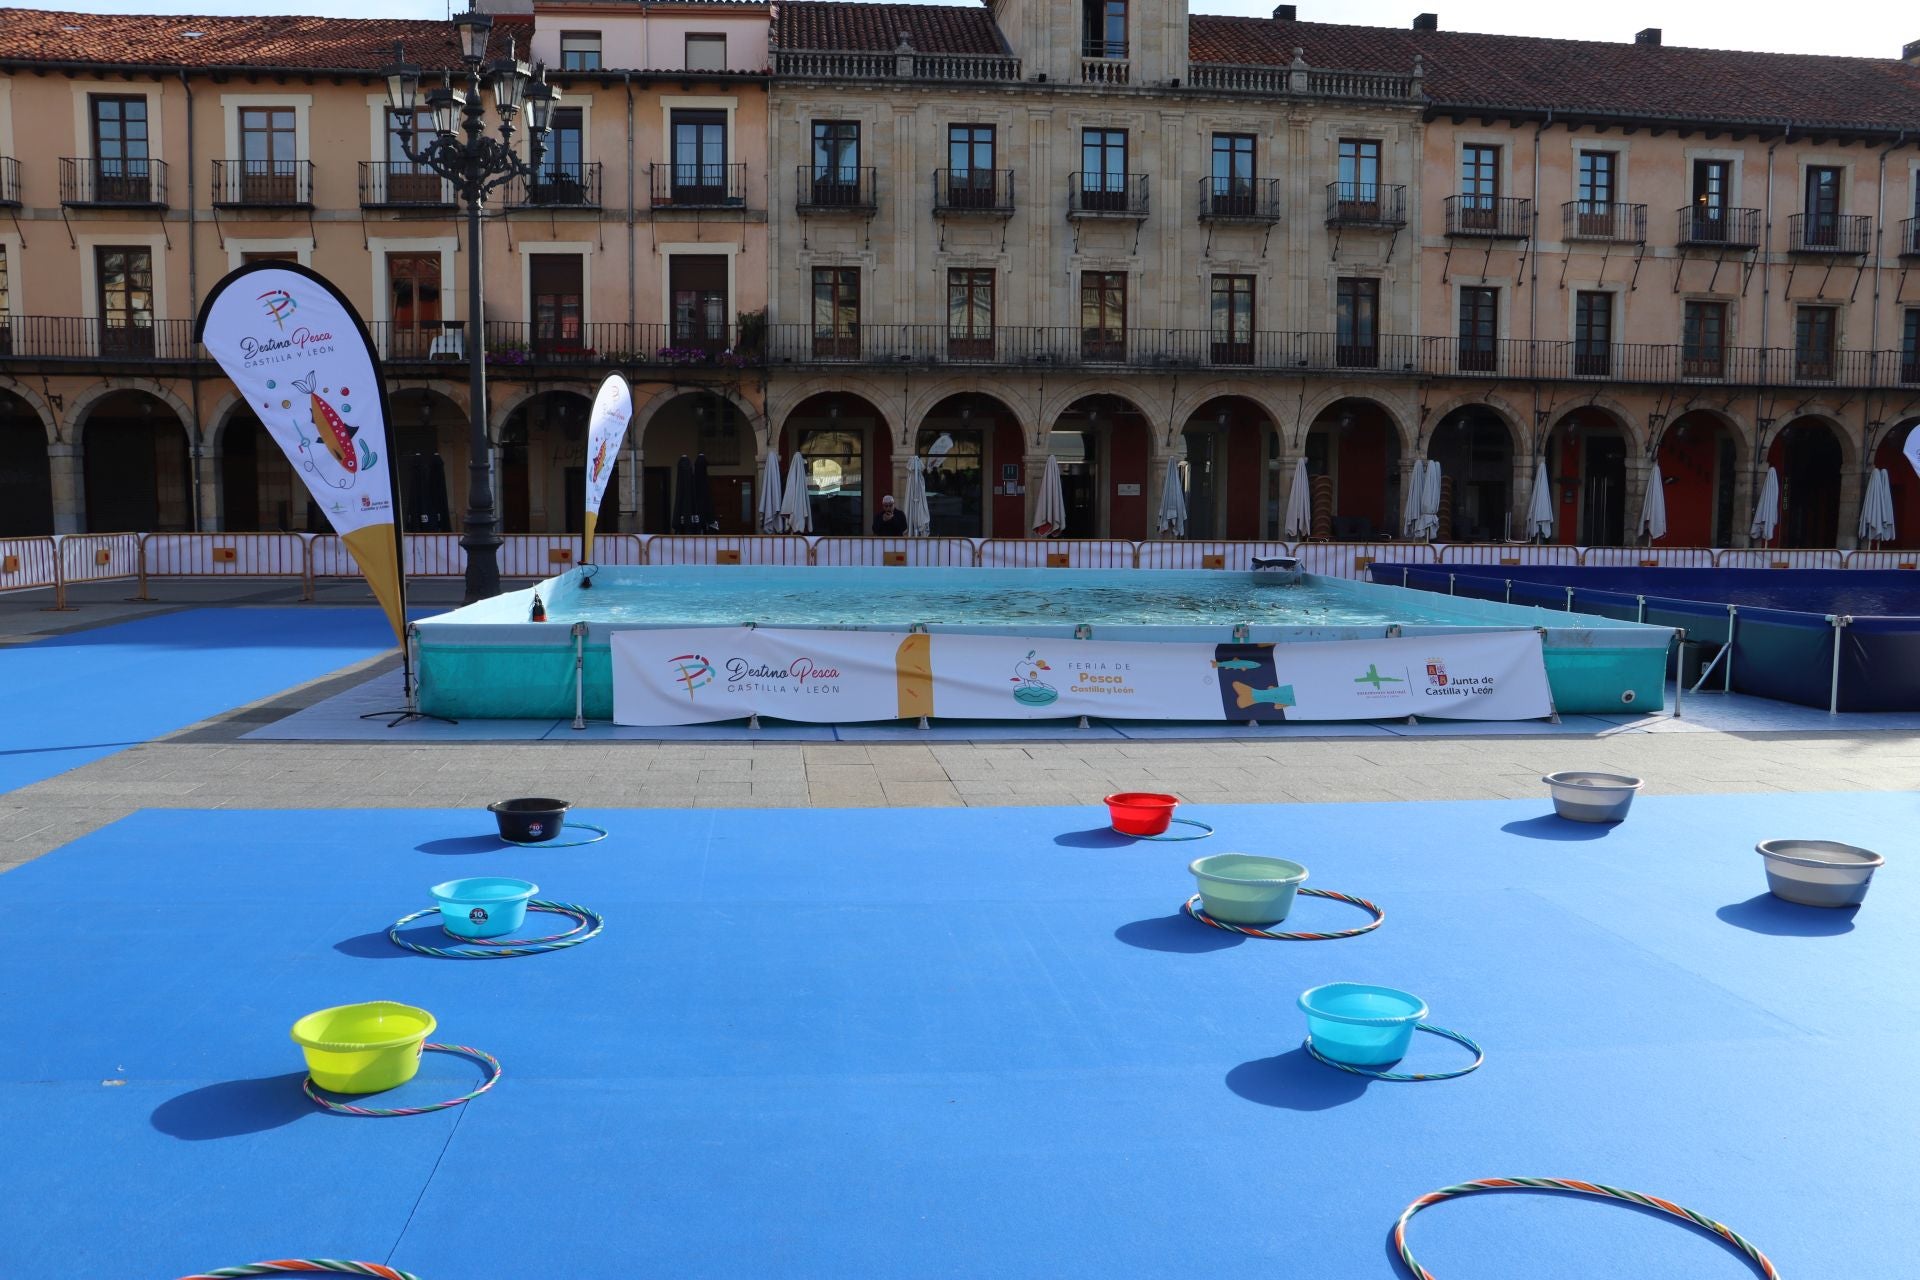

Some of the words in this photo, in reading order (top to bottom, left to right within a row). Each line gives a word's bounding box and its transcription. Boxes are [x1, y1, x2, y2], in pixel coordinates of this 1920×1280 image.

[240, 337, 291, 359] Destino
[292, 327, 333, 349] Pesca
[244, 353, 292, 368] CASTILLA
[307, 346, 334, 357] LEÓN
[725, 657, 788, 682] Destino
[789, 657, 840, 683] Pesca
[1068, 662, 1106, 670] FERIA
[1079, 672, 1123, 684] Pesca
[1451, 677, 1479, 685] Junta
[1481, 676, 1494, 684] de
[727, 683, 786, 693] CASTILLA
[806, 684, 840, 694] LEÓN
[1070, 685, 1105, 693] Castilla
[1107, 687, 1112, 695] y
[1114, 686, 1134, 694] León
[1425, 687, 1460, 696] Castilla
[1462, 688, 1469, 696] y
[1472, 686, 1493, 695] León
